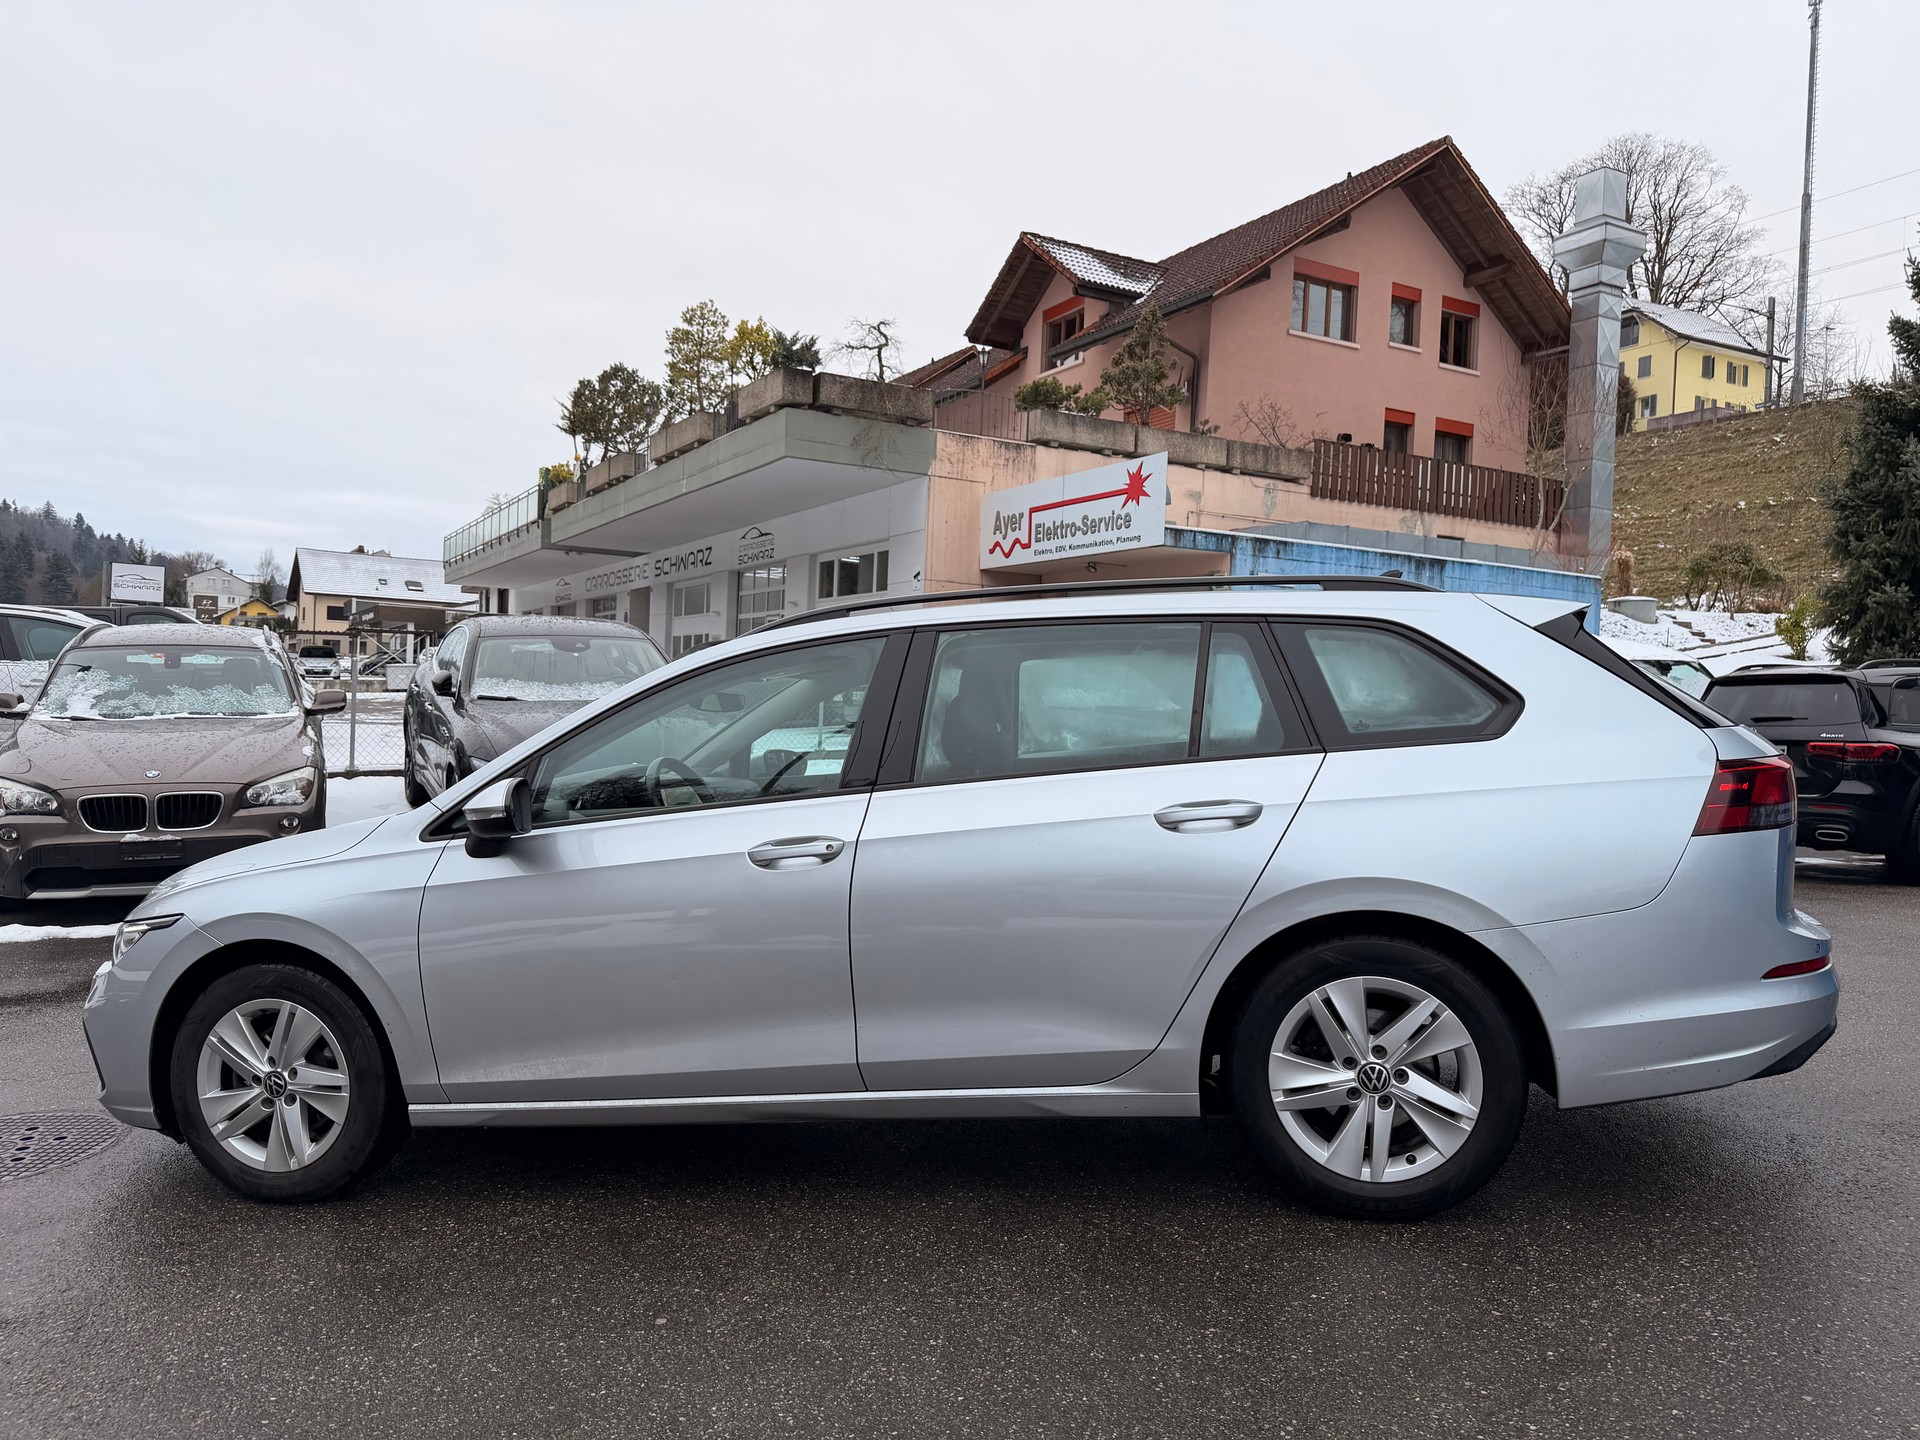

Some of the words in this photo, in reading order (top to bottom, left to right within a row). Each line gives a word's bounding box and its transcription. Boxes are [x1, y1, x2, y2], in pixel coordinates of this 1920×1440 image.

[993, 510, 1025, 540] Ayer
[1034, 510, 1132, 543] Elektro-Service
[738, 548, 775, 565] SCHWARZ
[1034, 547, 1054, 556] Elektro,
[1055, 545, 1068, 553] EDV,
[1068, 538, 1115, 551] Kommunikation,
[1116, 534, 1142, 545] Planung
[585, 562, 650, 592] CARROSSERIE
[654, 546, 713, 578] SCHWARZ
[113, 583, 162, 592] SCHWARZ
